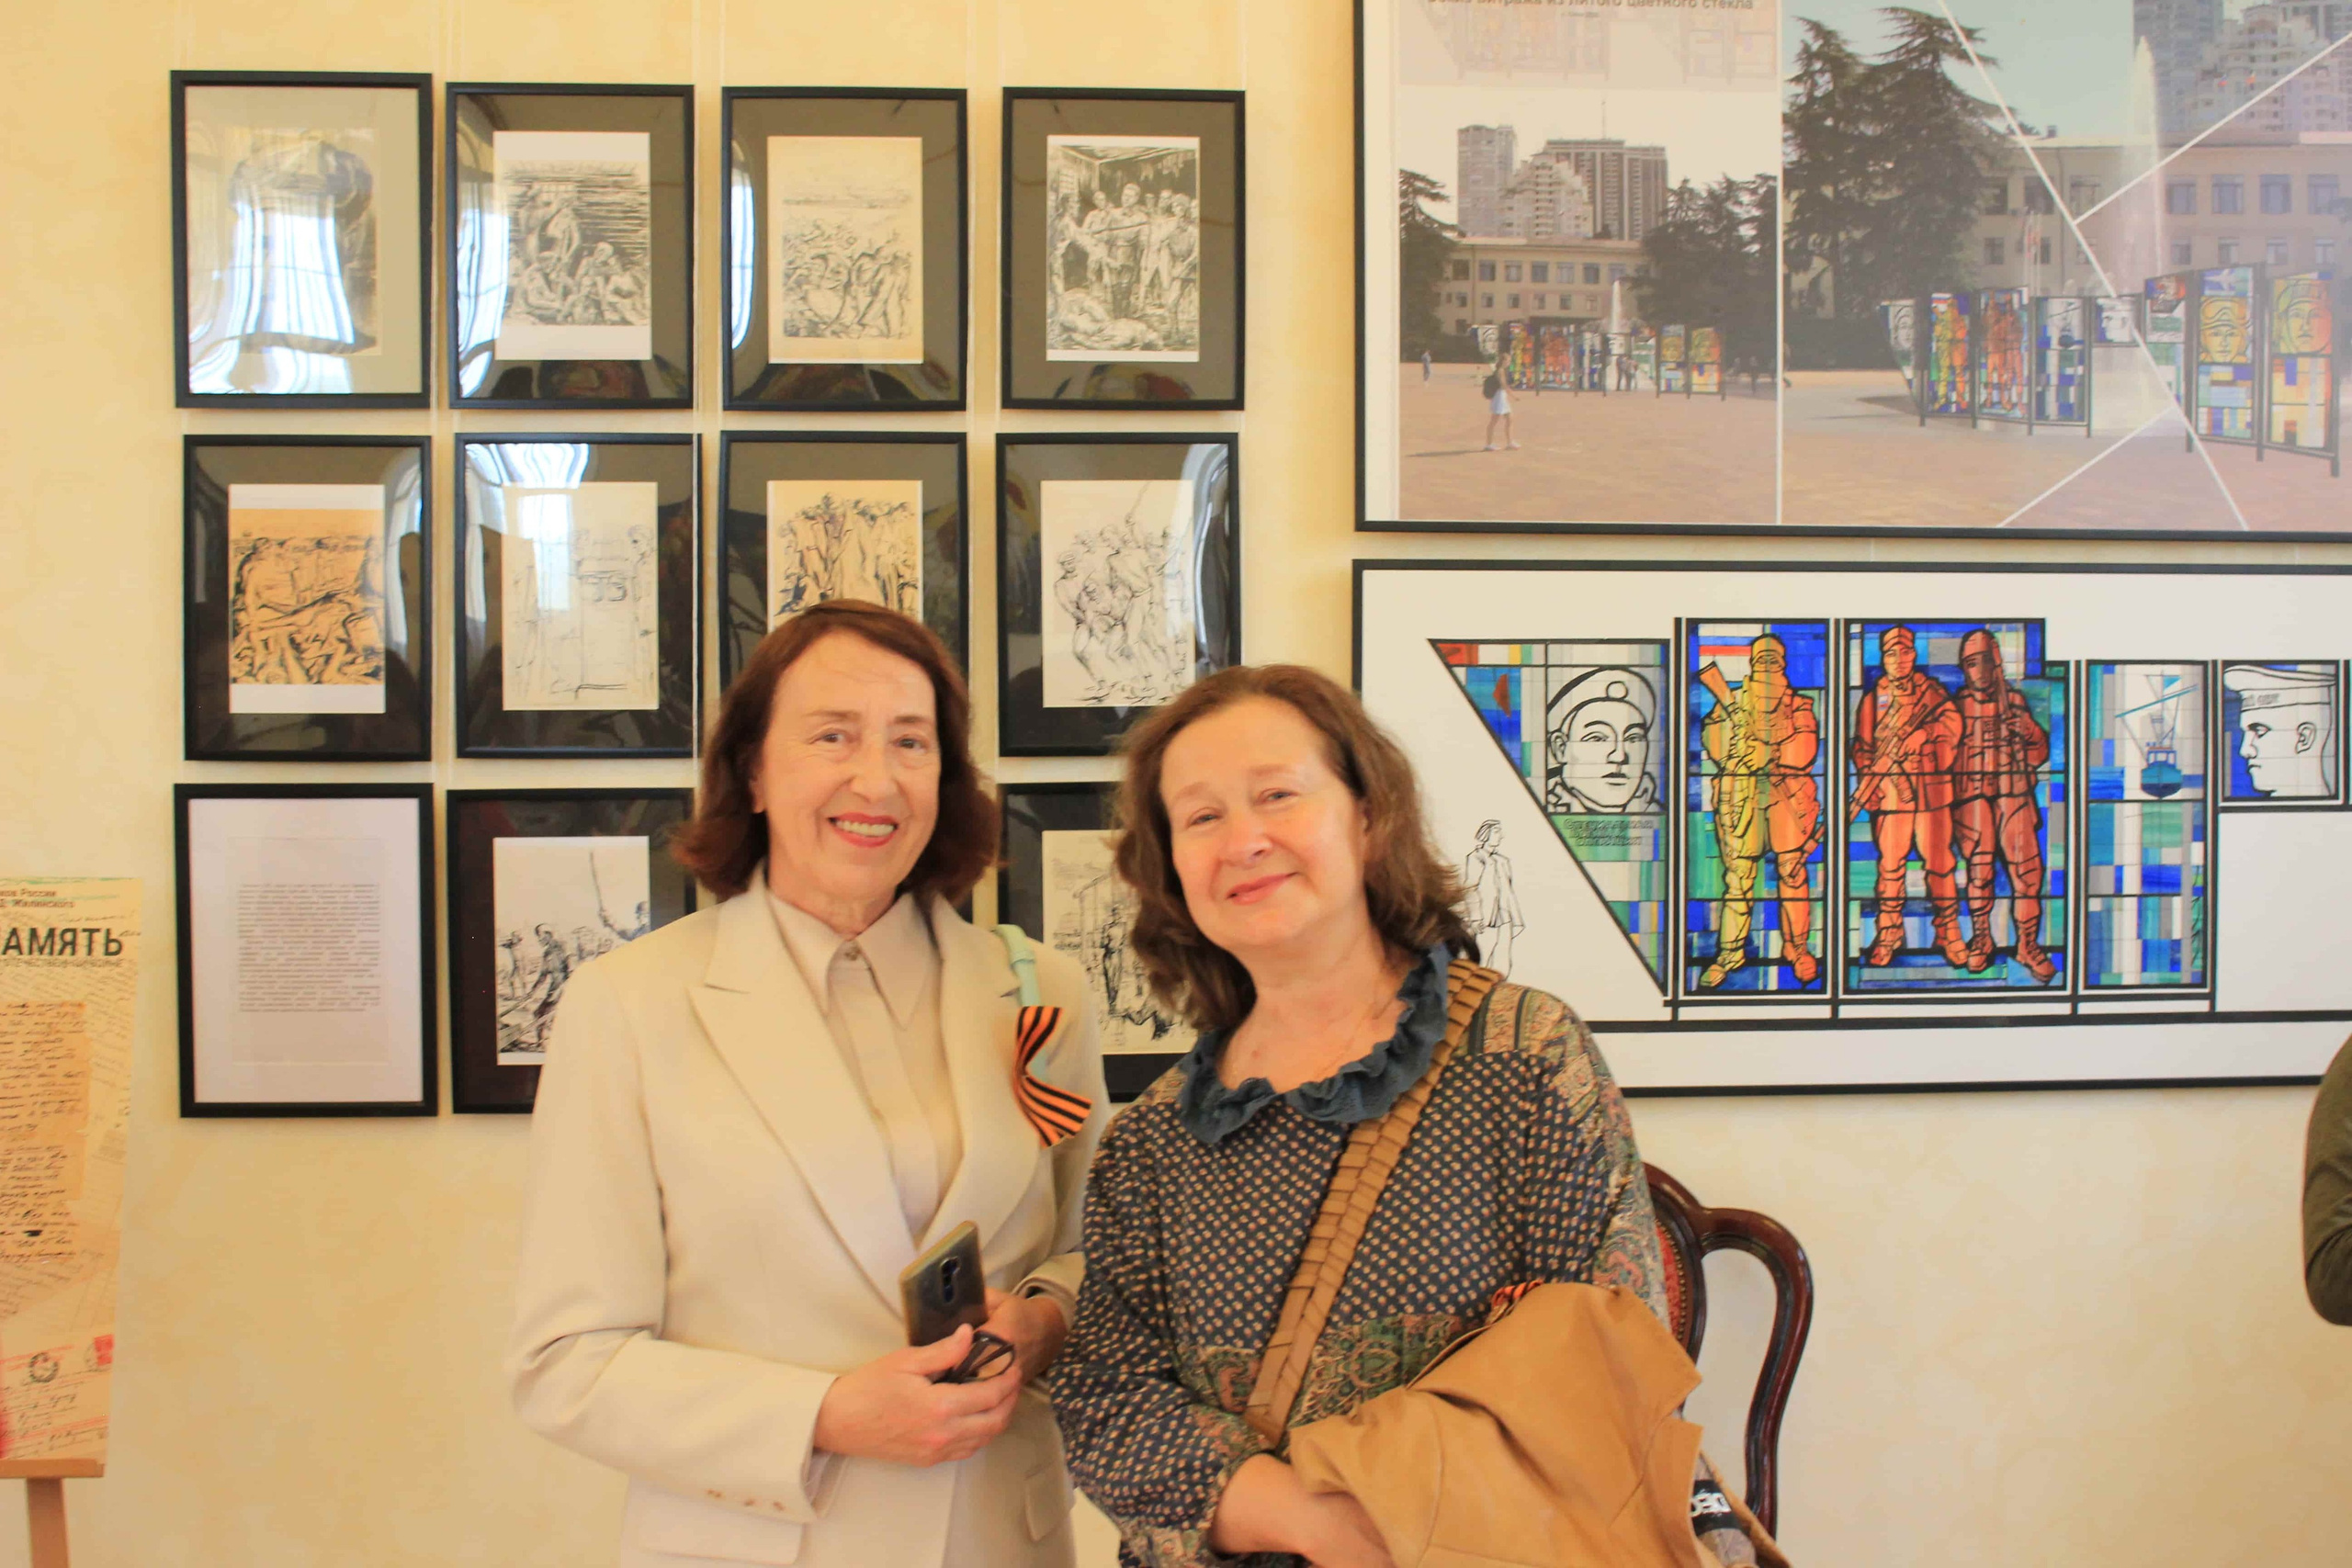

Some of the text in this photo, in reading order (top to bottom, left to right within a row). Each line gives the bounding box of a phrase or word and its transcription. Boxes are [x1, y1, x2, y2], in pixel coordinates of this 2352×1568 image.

[1627, 0, 1698, 8] цветного
[1702, 0, 1753, 9] стекла
[1, 927, 123, 956] АМЯТЬ
